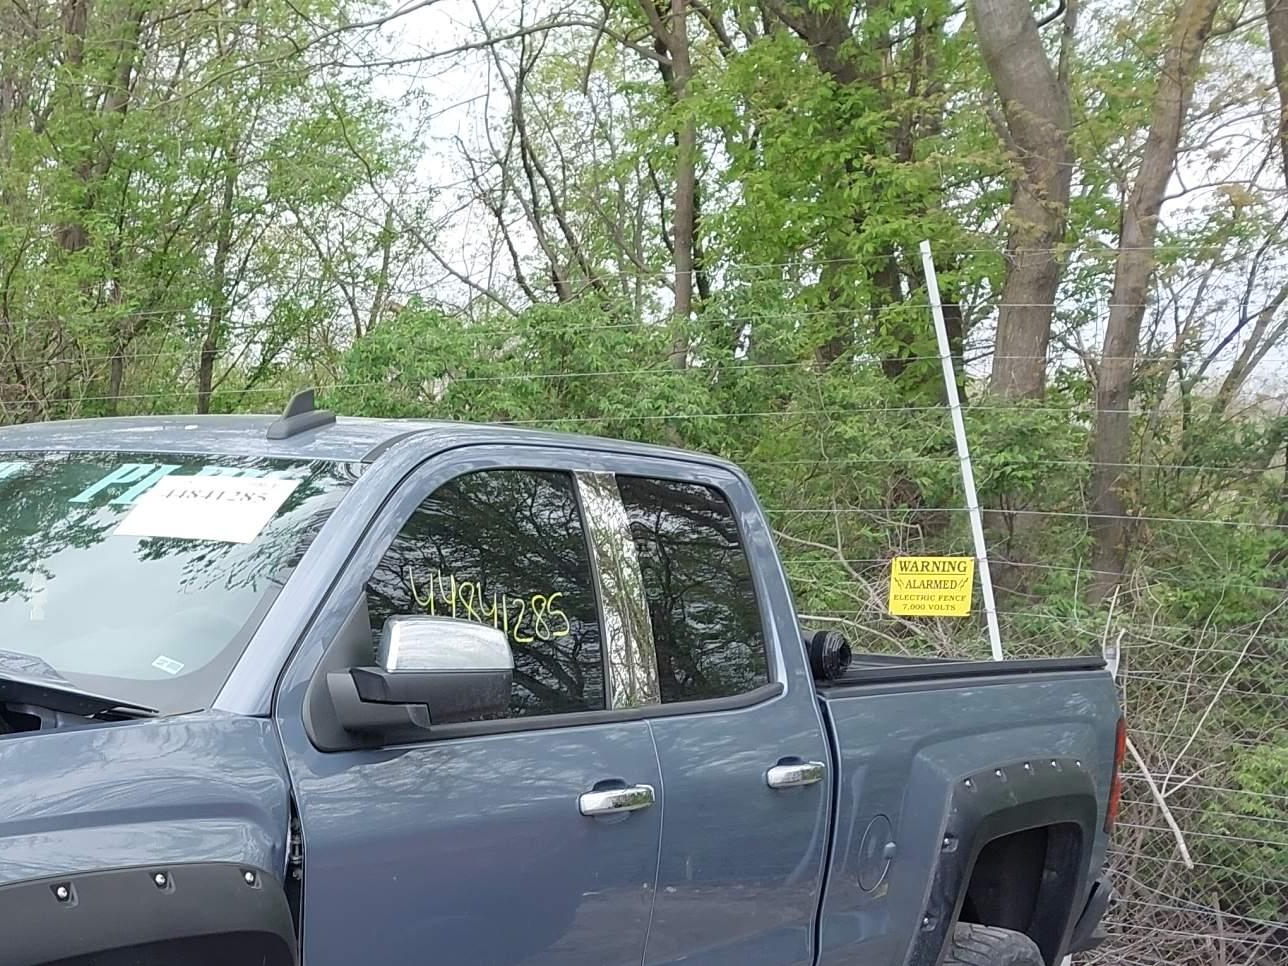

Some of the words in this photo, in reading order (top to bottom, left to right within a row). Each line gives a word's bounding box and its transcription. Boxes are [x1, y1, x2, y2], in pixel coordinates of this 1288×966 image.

[899, 560, 967, 573] WARNING
[905, 579, 958, 590] ALARMED
[938, 594, 967, 602] FENCE
[408, 566, 570, 643] 44841285
[928, 603, 956, 611] VOLTS
